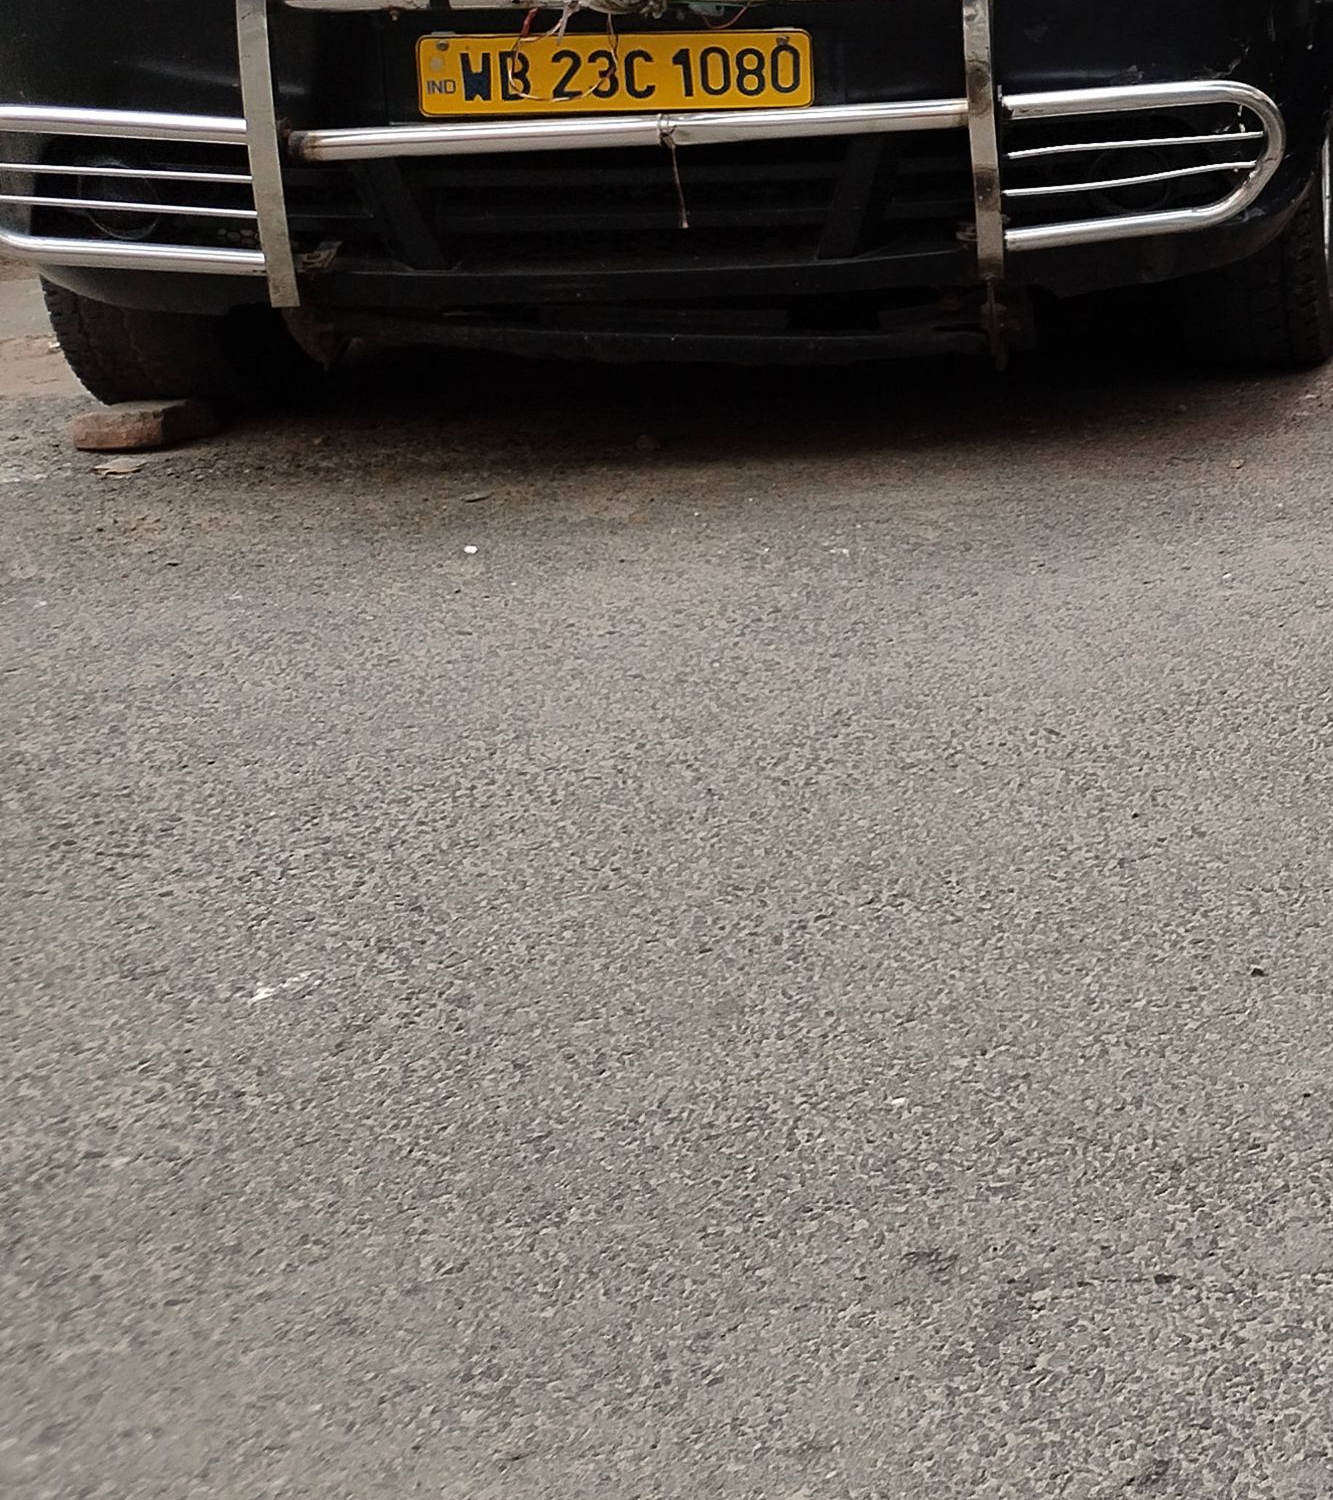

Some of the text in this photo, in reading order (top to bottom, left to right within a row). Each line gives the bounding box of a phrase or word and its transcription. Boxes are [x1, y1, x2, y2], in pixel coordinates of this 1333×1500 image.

[426, 79, 456, 95] IND
[460, 43, 802, 102] WB 23C 1080
